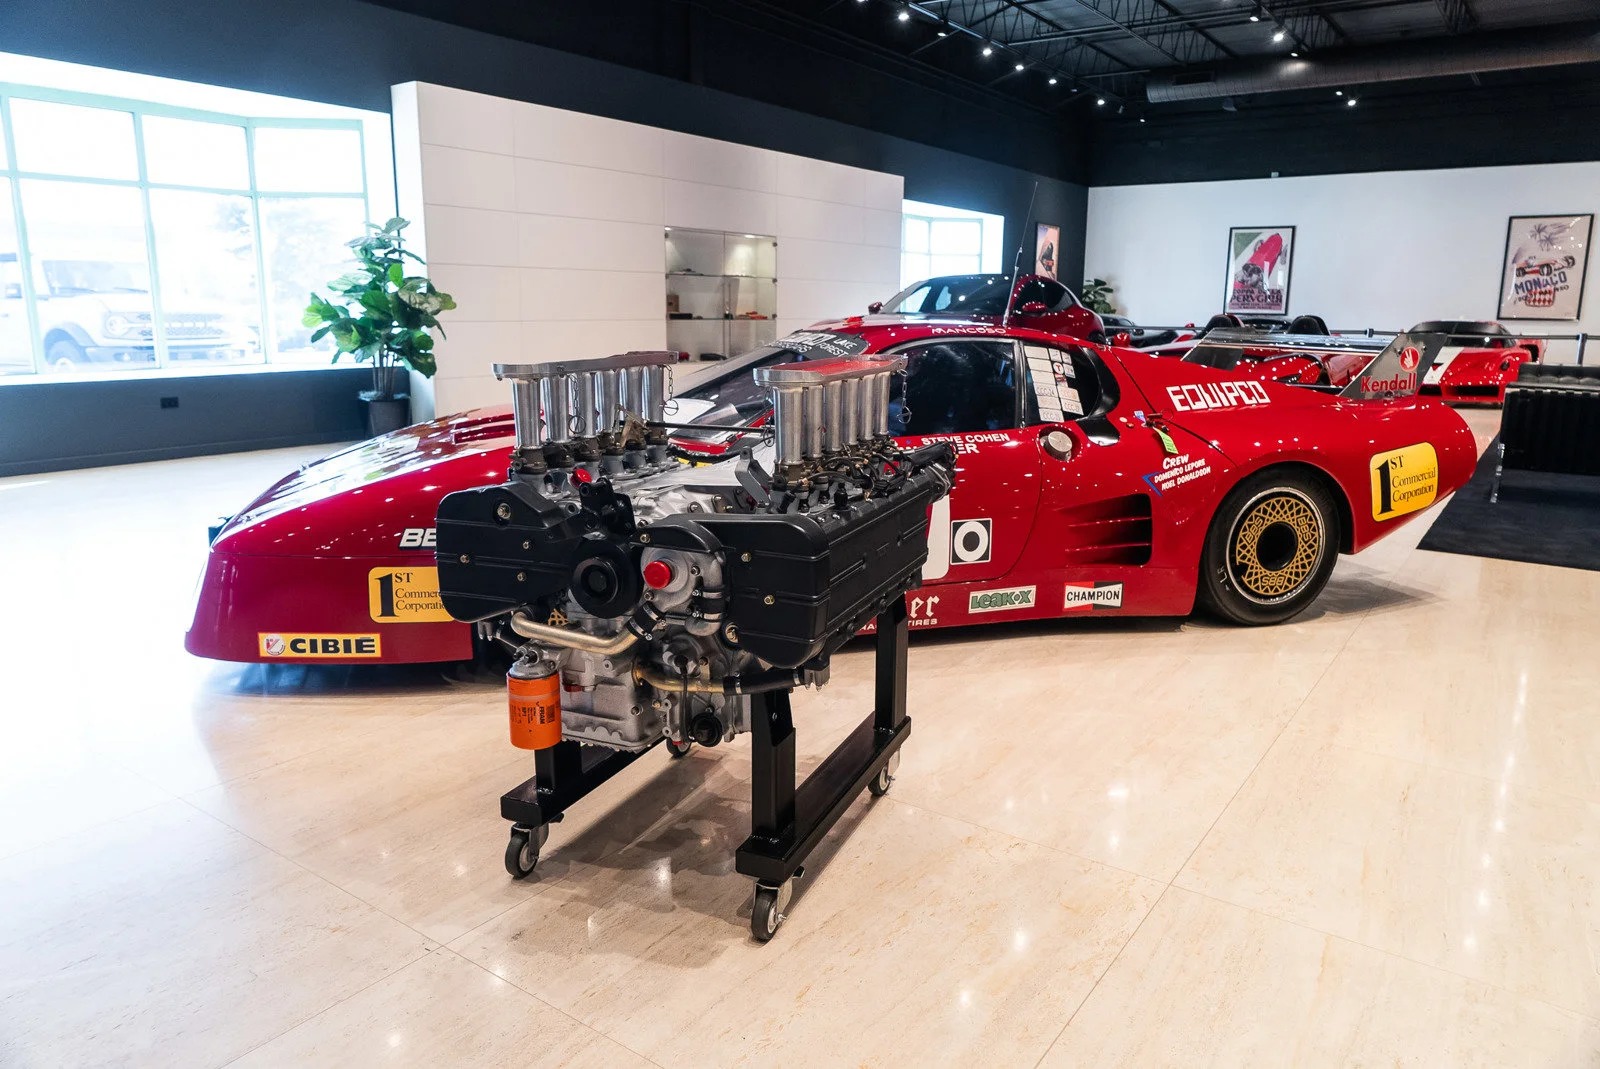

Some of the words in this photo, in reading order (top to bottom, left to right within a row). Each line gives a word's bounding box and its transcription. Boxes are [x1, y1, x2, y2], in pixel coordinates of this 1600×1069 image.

[1514, 271, 1567, 295] MONACO
[817, 342, 849, 357] FOREST
[833, 338, 857, 350] LAKE
[1360, 373, 1417, 393] Kendall
[1166, 380, 1271, 412] EQUIPCO
[966, 433, 1010, 443] COHEN
[1154, 467, 1184, 483] DOMENICO
[1184, 459, 1206, 473] LEPORE
[1161, 478, 1176, 491] NOEL
[1176, 466, 1211, 485] DONALDSON
[1392, 467, 1436, 488] Commercial
[1392, 484, 1434, 502] Corporation
[1245, 517, 1264, 543] BBS
[1298, 516, 1312, 541] BBS
[1261, 576, 1285, 587] BBS
[1066, 590, 1120, 602] CHAMPION
